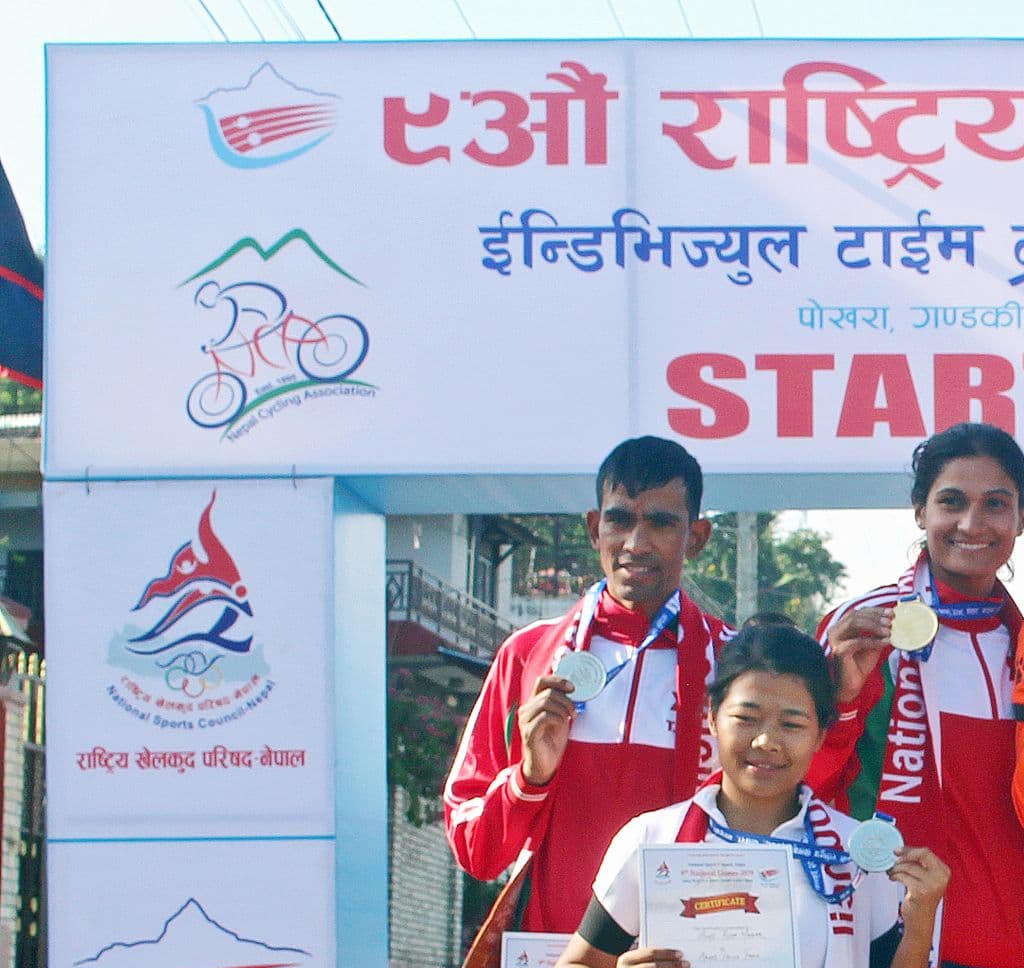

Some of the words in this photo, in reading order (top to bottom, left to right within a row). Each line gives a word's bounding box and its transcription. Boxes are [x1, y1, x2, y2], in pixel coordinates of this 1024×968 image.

[834, 209, 984, 275] टाईम
[910, 300, 1022, 330] गण्डकी
[257, 394, 302, 418] Cycling
[303, 385, 377, 400] Association
[152, 714, 195, 730] Sports
[76, 745, 130, 774] राष्ट्रिय
[135, 746, 196, 773] खेलकुद
[202, 744, 253, 770] परिषद
[259, 745, 306, 768] नेपाल
